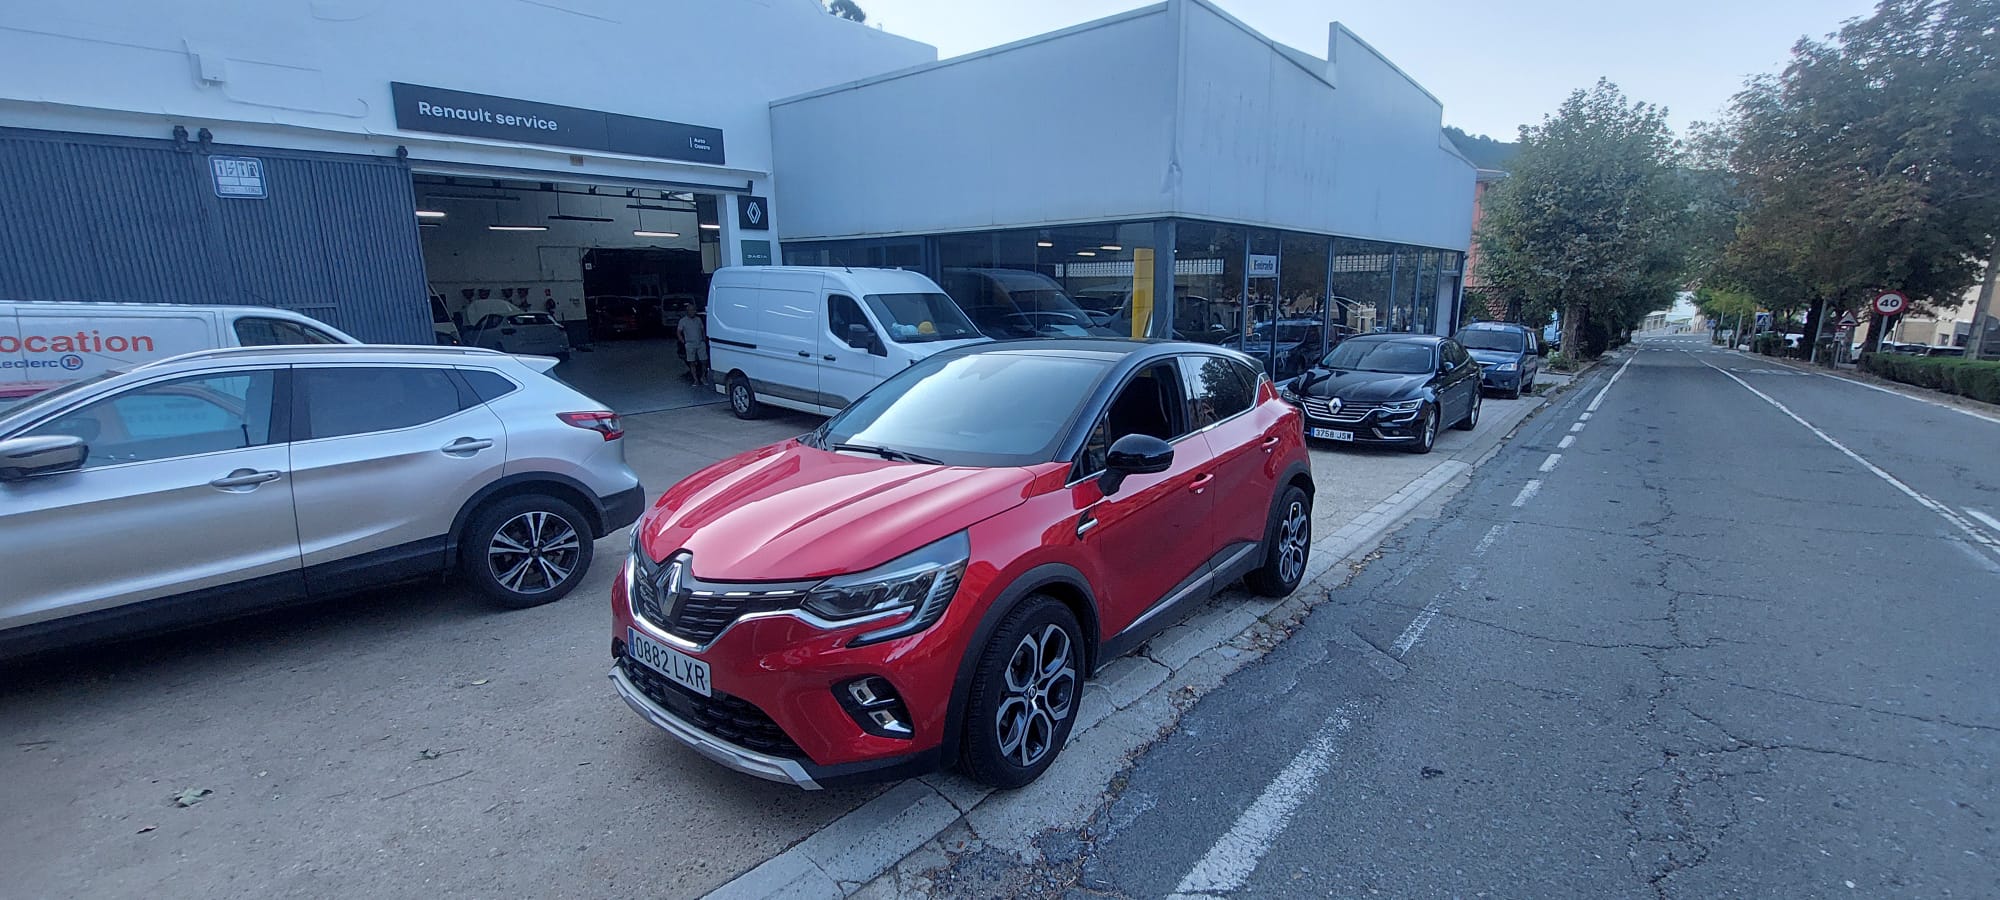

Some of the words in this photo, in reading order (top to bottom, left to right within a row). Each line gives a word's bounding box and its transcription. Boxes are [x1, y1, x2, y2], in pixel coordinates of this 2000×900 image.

[418, 101, 492, 123] Renault
[495, 112, 558, 131] service
[1880, 299, 1899, 308] 40
[0, 359, 59, 369] eclerc
[635, 636, 670, 675] 0882
[673, 655, 706, 691] LXR
